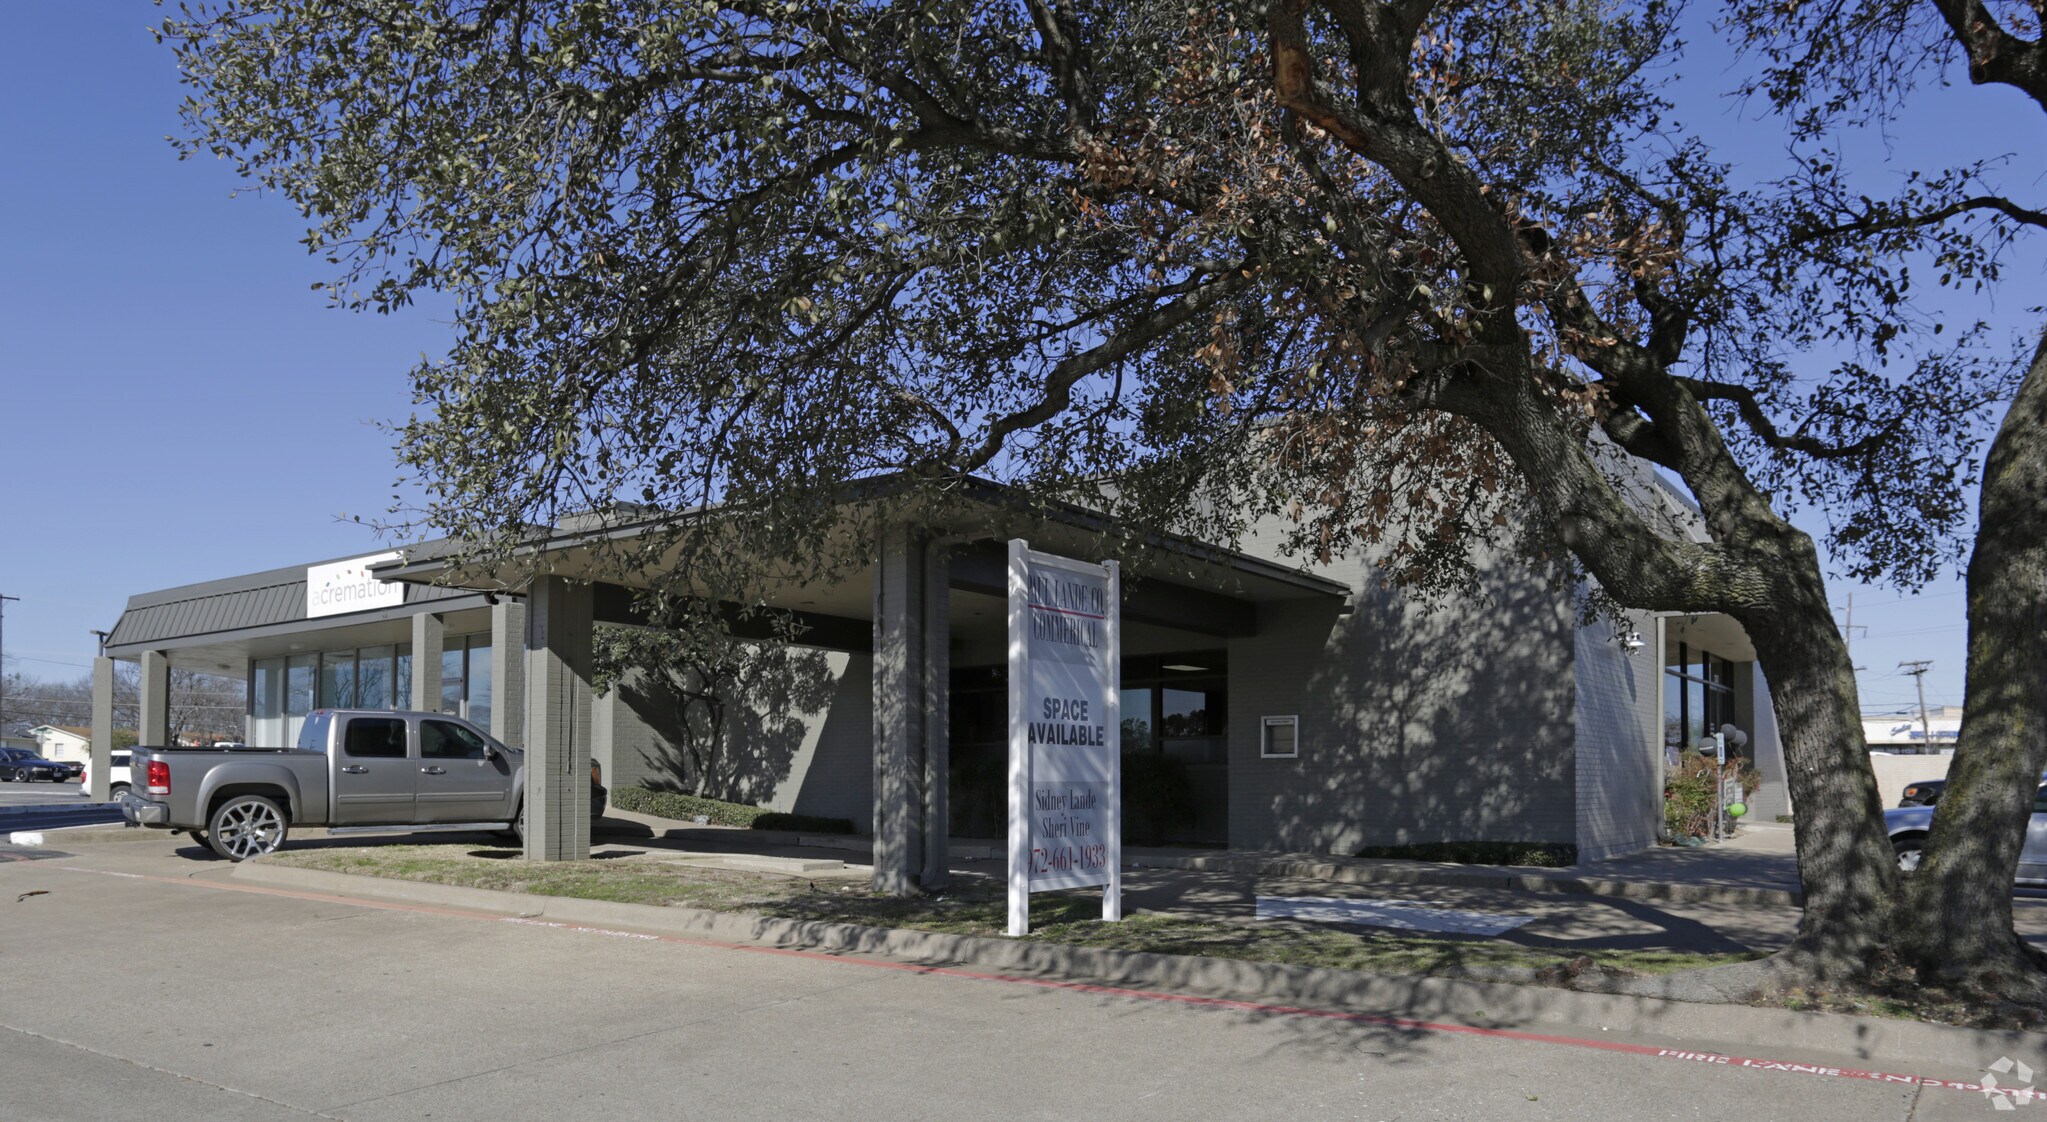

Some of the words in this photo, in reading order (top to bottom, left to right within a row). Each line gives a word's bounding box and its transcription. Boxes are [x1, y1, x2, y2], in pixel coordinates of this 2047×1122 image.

[1055, 580, 1087, 612] LANDE
[1091, 587, 1105, 615] CO.
[1033, 613, 1098, 648] COMMERICAL
[1043, 697, 1088, 722] SPACE
[1028, 721, 1104, 747] AVAILABLE
[1035, 789, 1067, 816] Sidney
[1070, 788, 1096, 810] Lande
[1042, 816, 1067, 839] Sheri
[1069, 815, 1090, 837] Vine
[1028, 844, 1106, 874] 972-661-1933
[1658, 1049, 1731, 1064] FIRE
[1743, 1059, 1841, 1076] LANE
